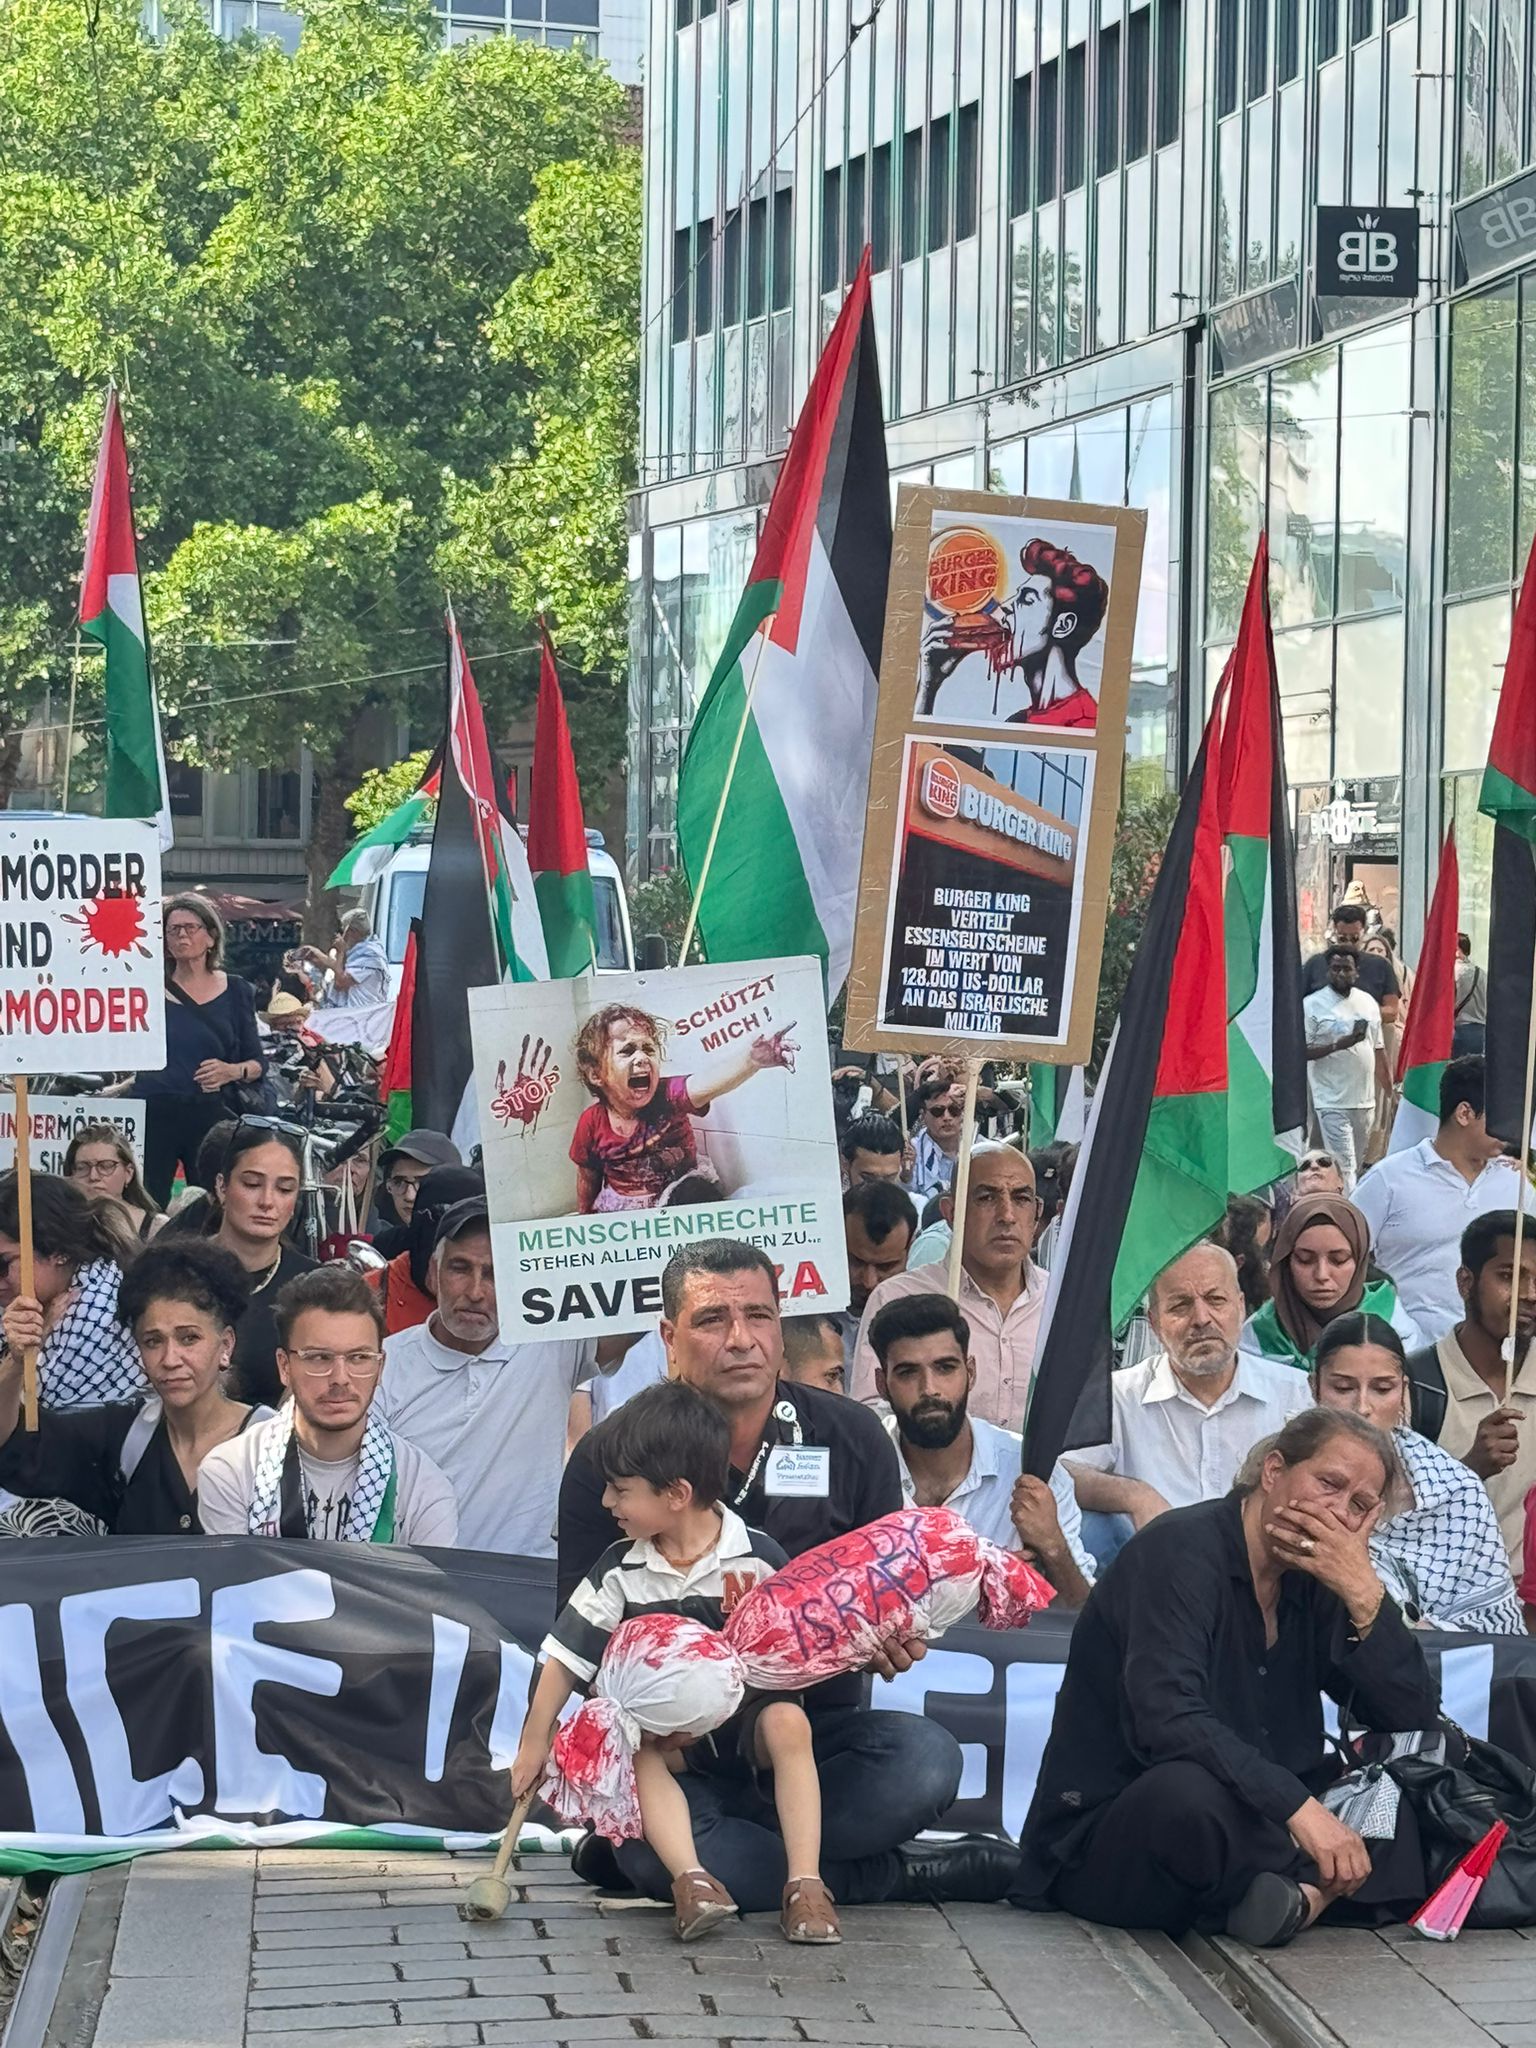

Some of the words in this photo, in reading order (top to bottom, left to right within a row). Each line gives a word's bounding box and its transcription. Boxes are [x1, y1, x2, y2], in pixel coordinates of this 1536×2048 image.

[931, 566, 998, 601] KING
[961, 783, 1037, 846] BURGER
[934, 888, 991, 910] BURGER
[994, 892, 1031, 913] KING
[951, 909, 1015, 931] VERTEILT
[904, 926, 1047, 955] ESSENSGUTSCHEINE
[925, 948, 945, 967] IM
[948, 951, 990, 971] WERT
[992, 954, 1023, 974] VON
[901, 967, 959, 989] 128.000
[962, 972, 1044, 996] US-DOLLAR
[674, 974, 775, 1036] SCHÜTZT
[901, 988, 925, 1007] AN
[927, 990, 958, 1010] DAS
[960, 992, 1049, 1017] ISRAELISCHE
[944, 1011, 1002, 1034] MILITÄR
[490, 1071, 561, 1120] STOP
[518, 1202, 818, 1252] MENSCHENRECHTE
[519, 1252, 595, 1273] STEHEN
[600, 1244, 662, 1265] ALLEN
[521, 1275, 663, 1325] SAVE
[790, 1546, 957, 1662] ISRAEL
